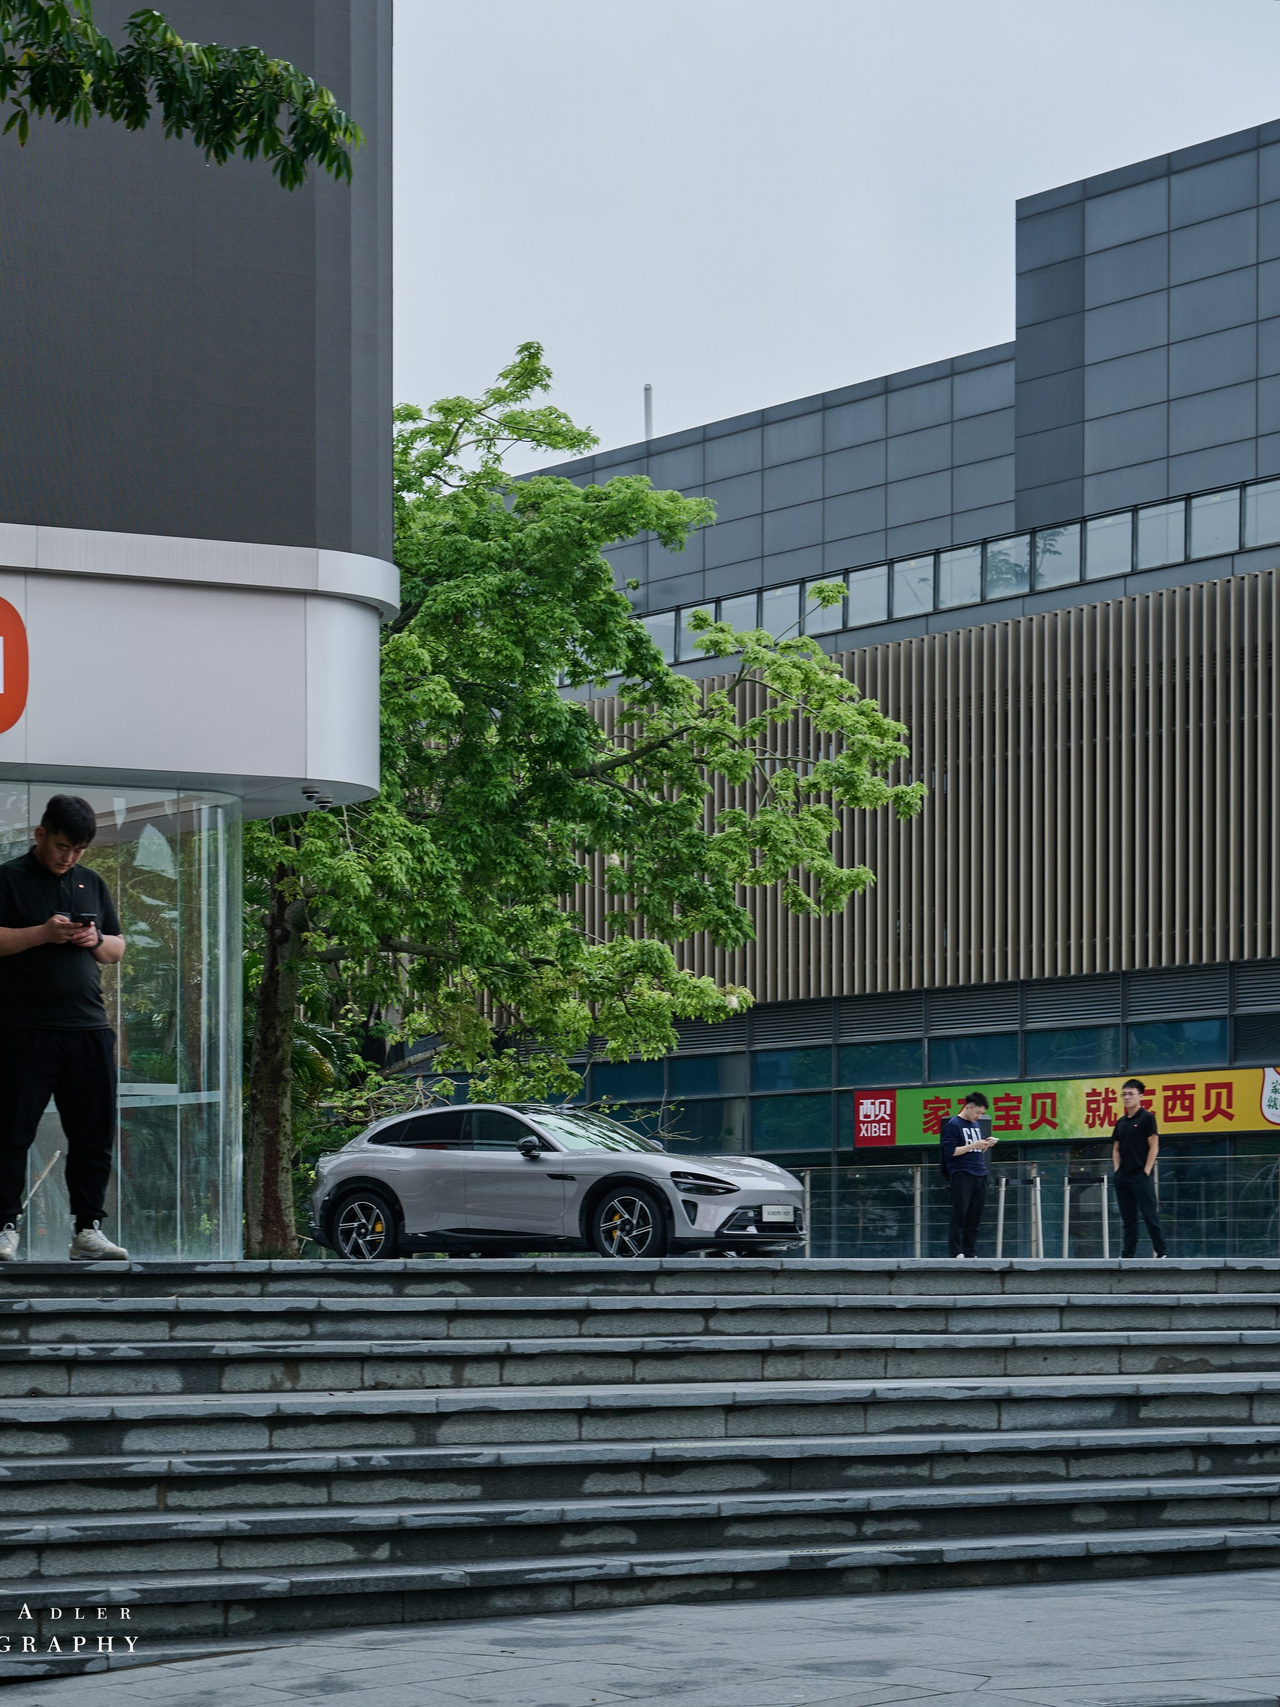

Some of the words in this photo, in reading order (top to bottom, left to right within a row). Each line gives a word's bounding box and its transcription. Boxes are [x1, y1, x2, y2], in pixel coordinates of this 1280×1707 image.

[922, 1092, 1059, 1135] 家宝贝
[859, 1123, 891, 1137] XIBEI
